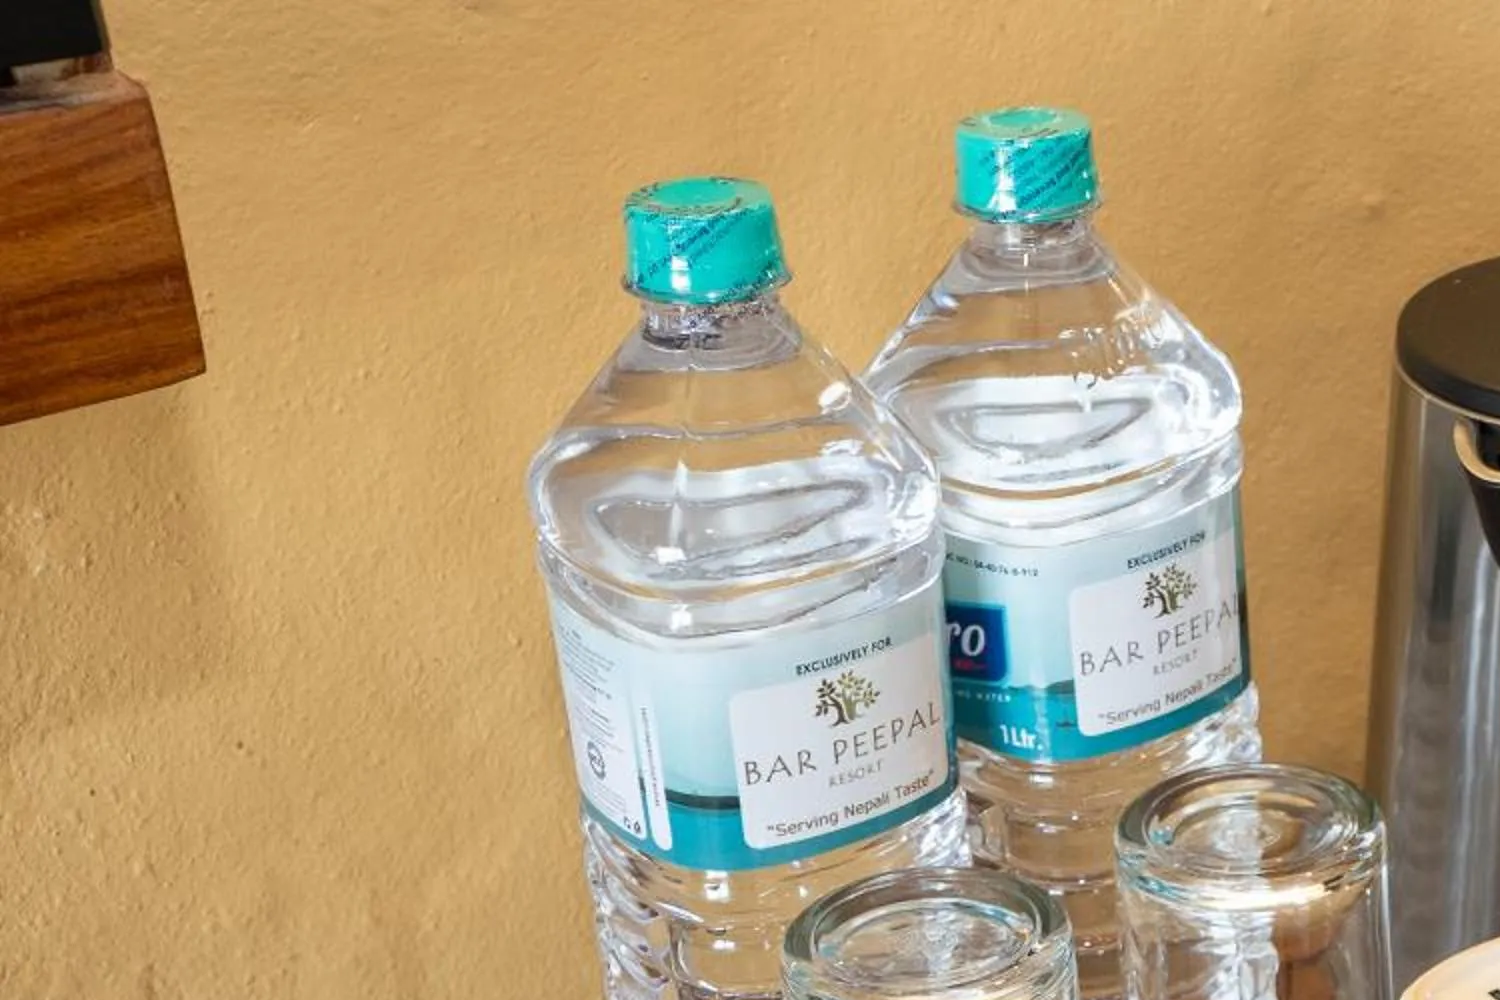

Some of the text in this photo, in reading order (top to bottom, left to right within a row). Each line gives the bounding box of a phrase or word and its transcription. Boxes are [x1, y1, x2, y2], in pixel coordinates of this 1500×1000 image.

[796, 636, 893, 675] EXCLUSIVELY FOR
[1080, 641, 1144, 676] BAR
[1153, 649, 1198, 675] RESORT
[744, 702, 941, 786] BAR PEEPAL
[829, 759, 884, 788] RESORT
[844, 792, 891, 818] Nepali
